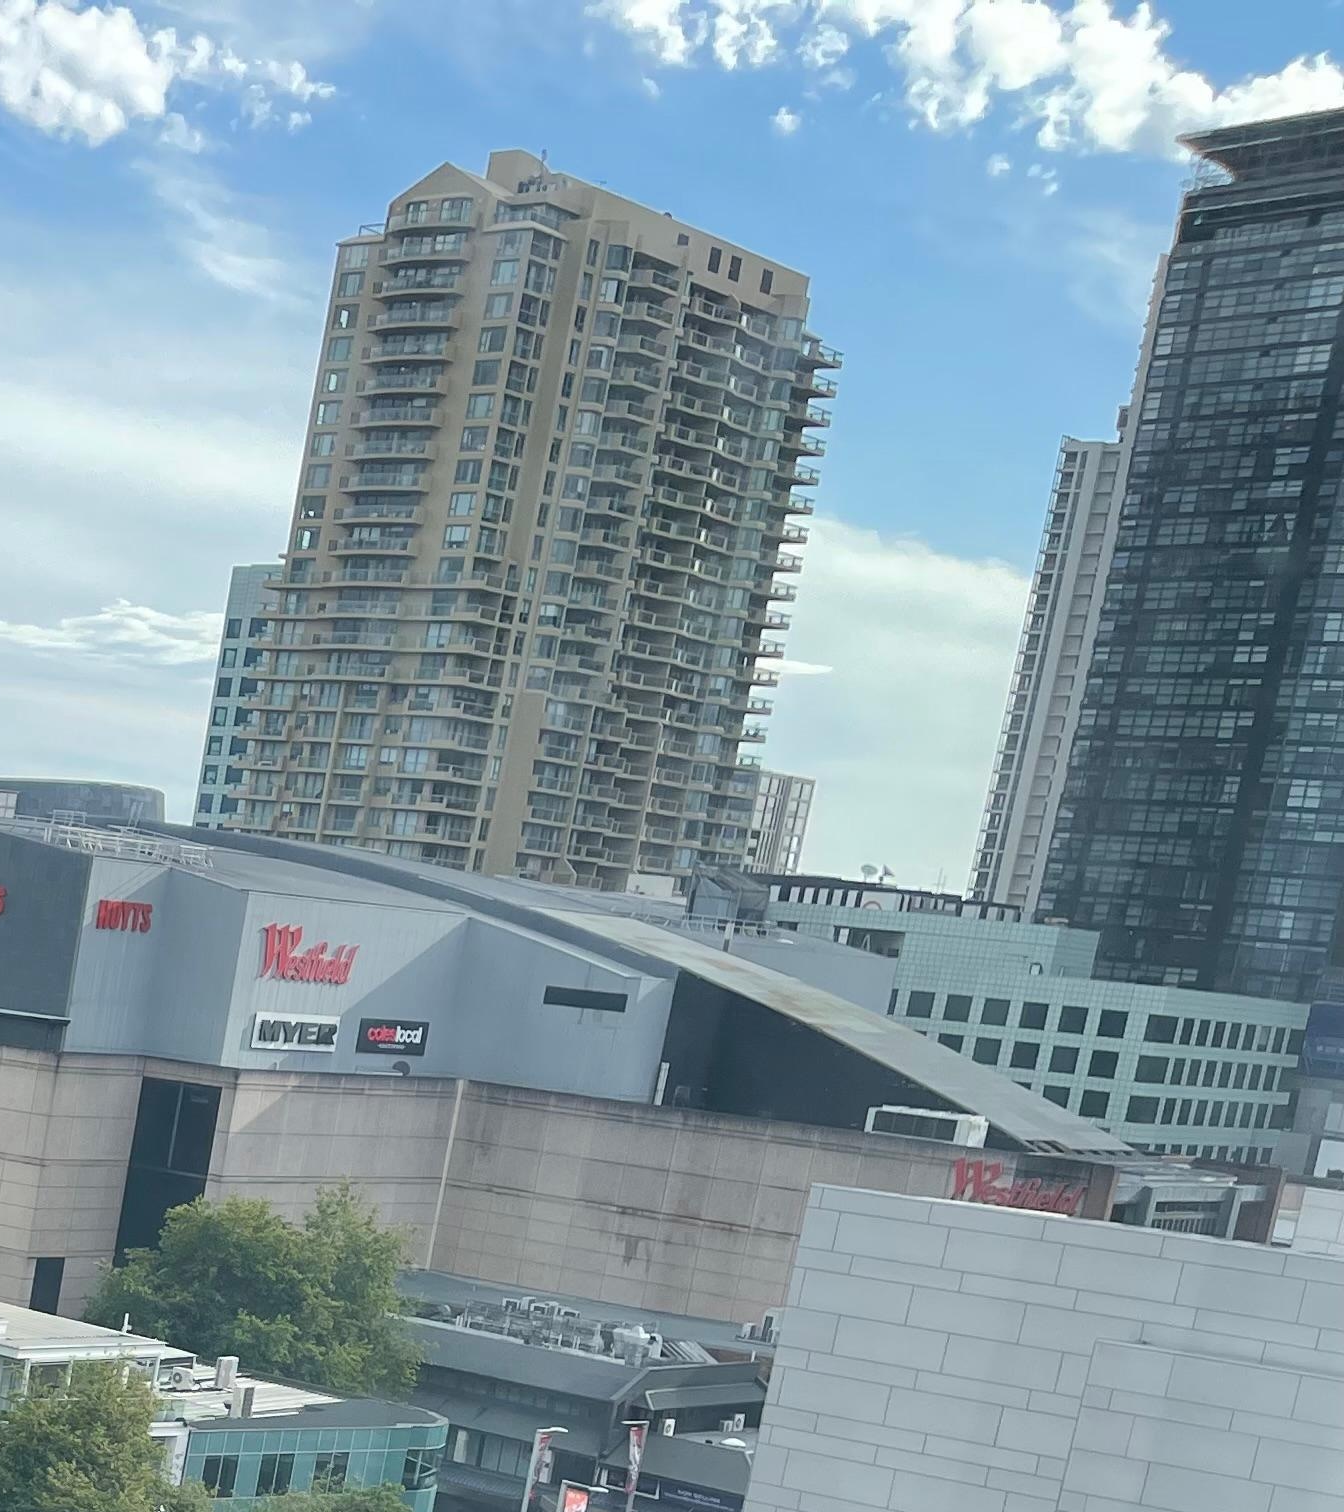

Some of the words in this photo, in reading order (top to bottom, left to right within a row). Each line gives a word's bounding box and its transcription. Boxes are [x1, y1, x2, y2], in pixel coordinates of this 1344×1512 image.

[96, 899, 153, 933] HOYTS
[260, 922, 360, 985] Westfield
[258, 1019, 338, 1046] MYER
[951, 1157, 1090, 1216] Westfield
